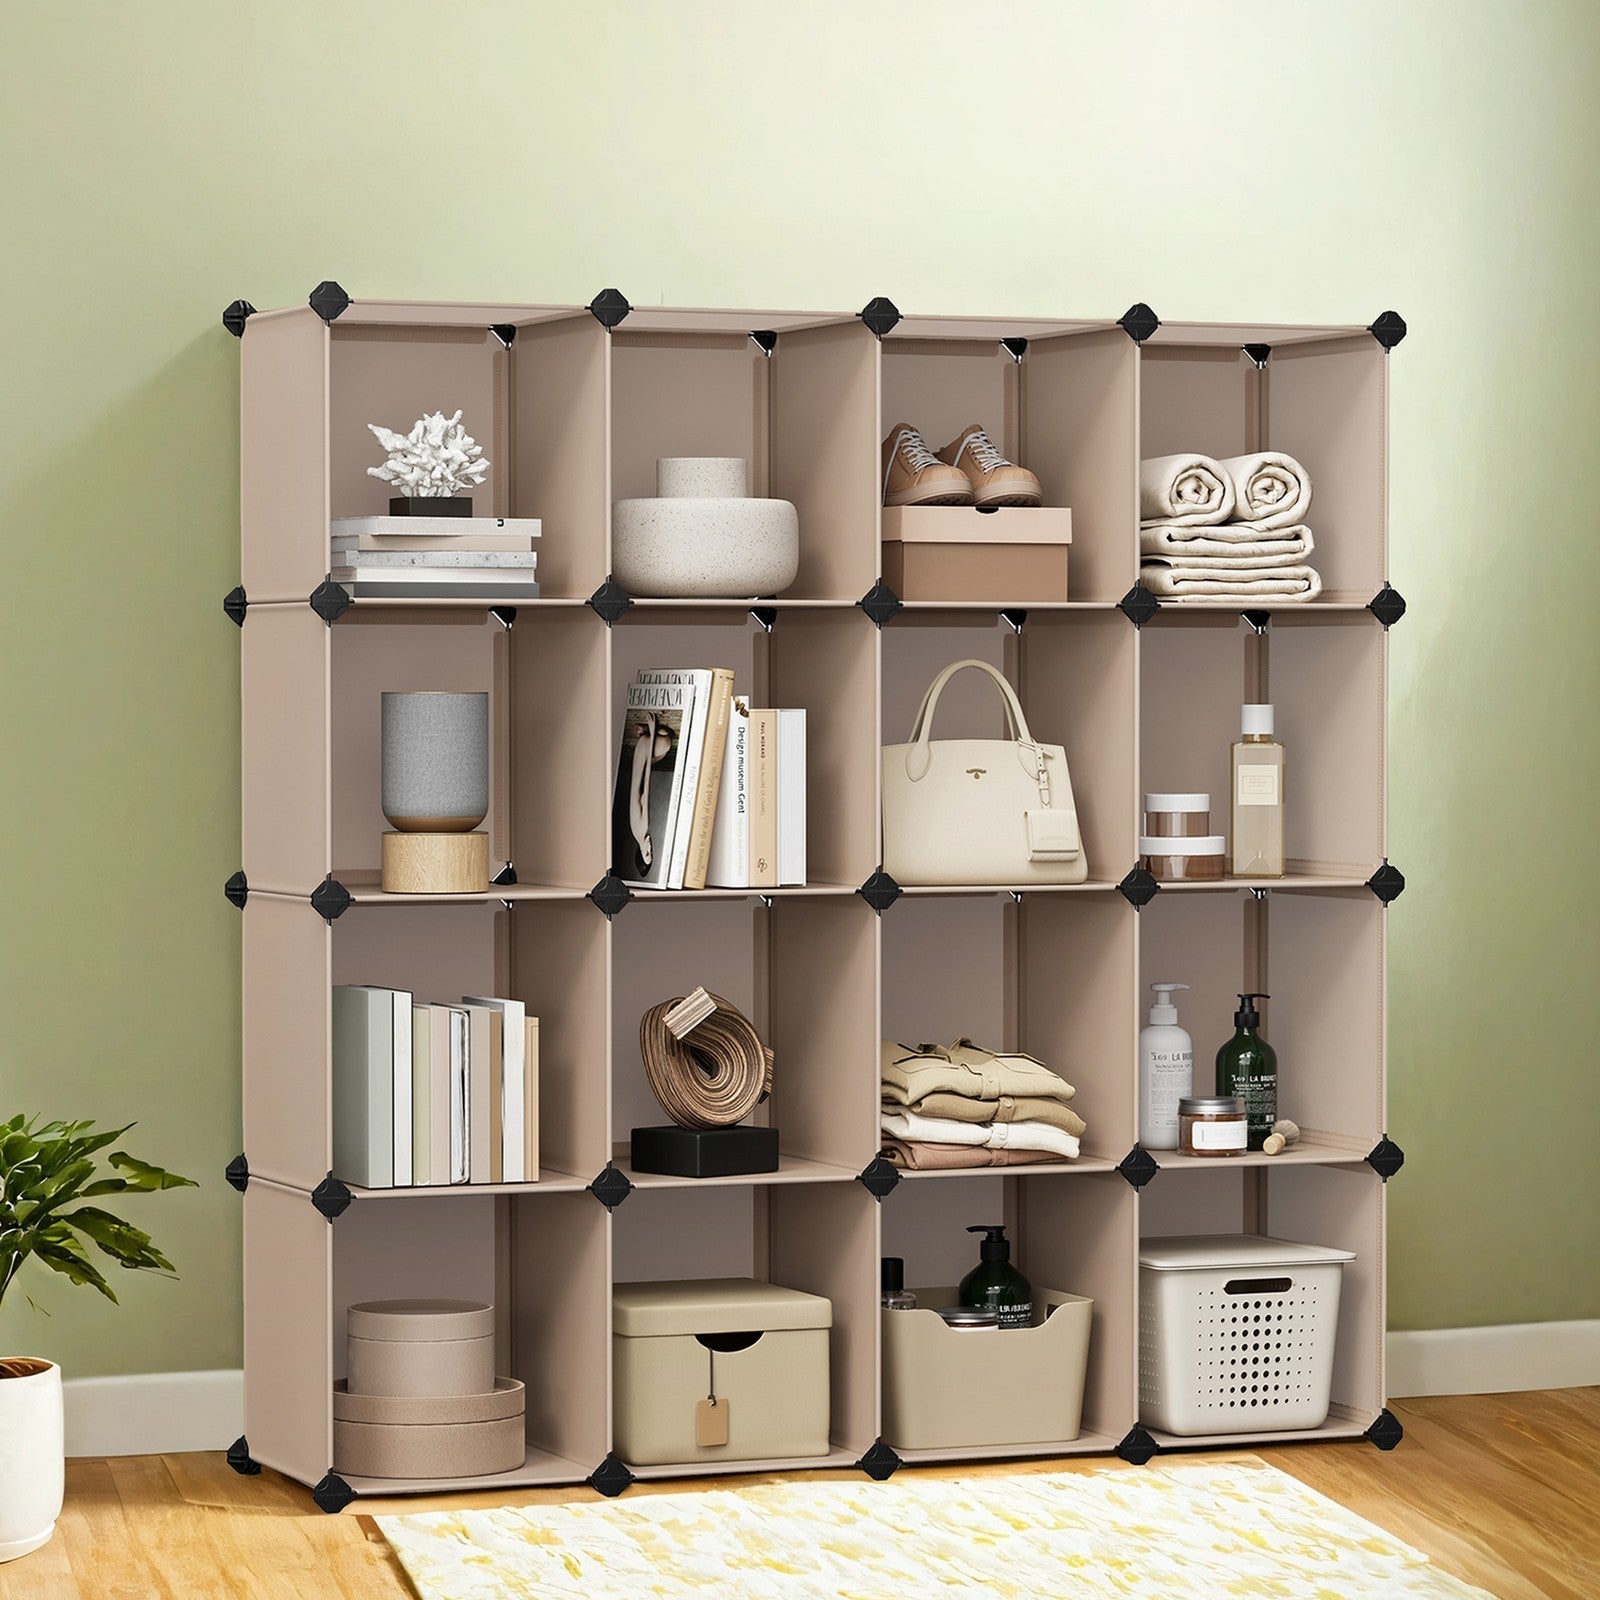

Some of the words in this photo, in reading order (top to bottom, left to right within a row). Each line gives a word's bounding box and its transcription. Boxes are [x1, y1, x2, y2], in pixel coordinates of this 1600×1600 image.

[735, 726, 746, 755] Design
[737, 756, 745, 792] museum
[737, 793, 746, 814] Gent
